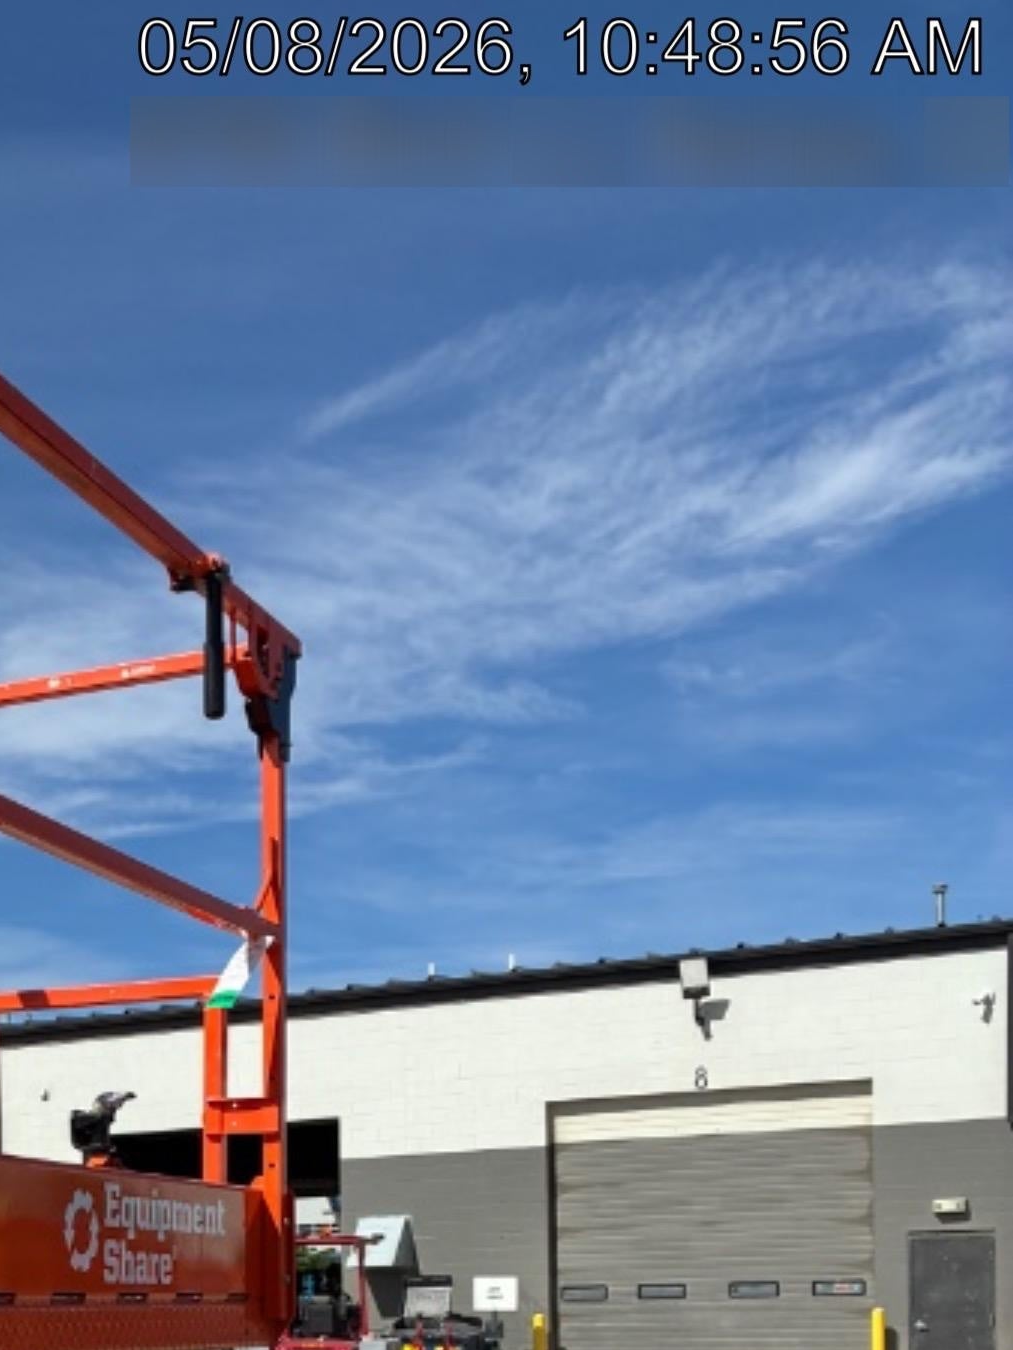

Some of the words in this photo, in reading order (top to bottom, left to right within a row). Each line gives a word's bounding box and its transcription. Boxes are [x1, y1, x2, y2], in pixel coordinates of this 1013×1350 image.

[694, 1066, 708, 1090] 8
[103, 1181, 225, 1242] Equipment
[103, 1238, 173, 1285] Share
